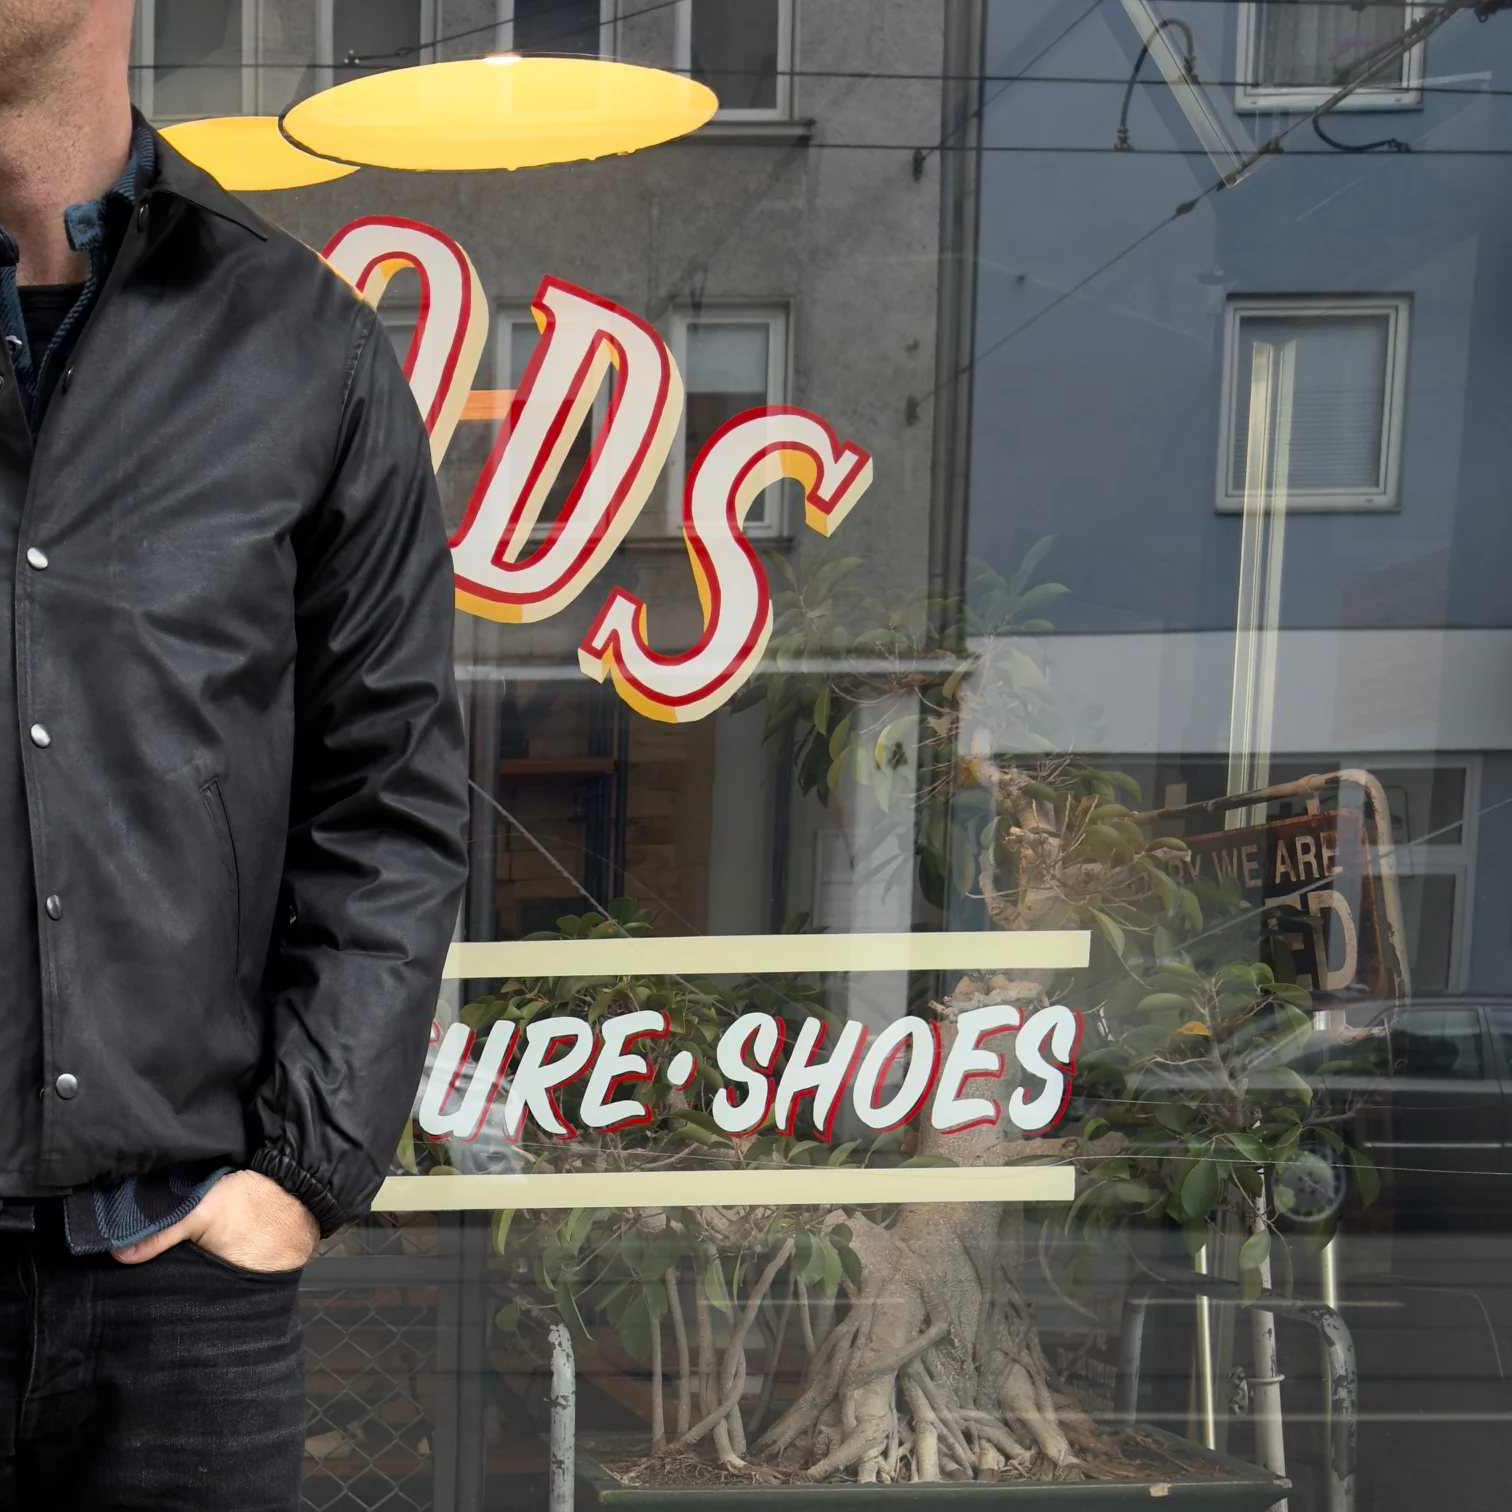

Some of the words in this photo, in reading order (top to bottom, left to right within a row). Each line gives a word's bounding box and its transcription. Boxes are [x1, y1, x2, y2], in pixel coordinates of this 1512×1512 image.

[1275, 832, 1343, 884] ARE
[418, 1010, 670, 1143] URE
[713, 1005, 1083, 1142] SHOES
